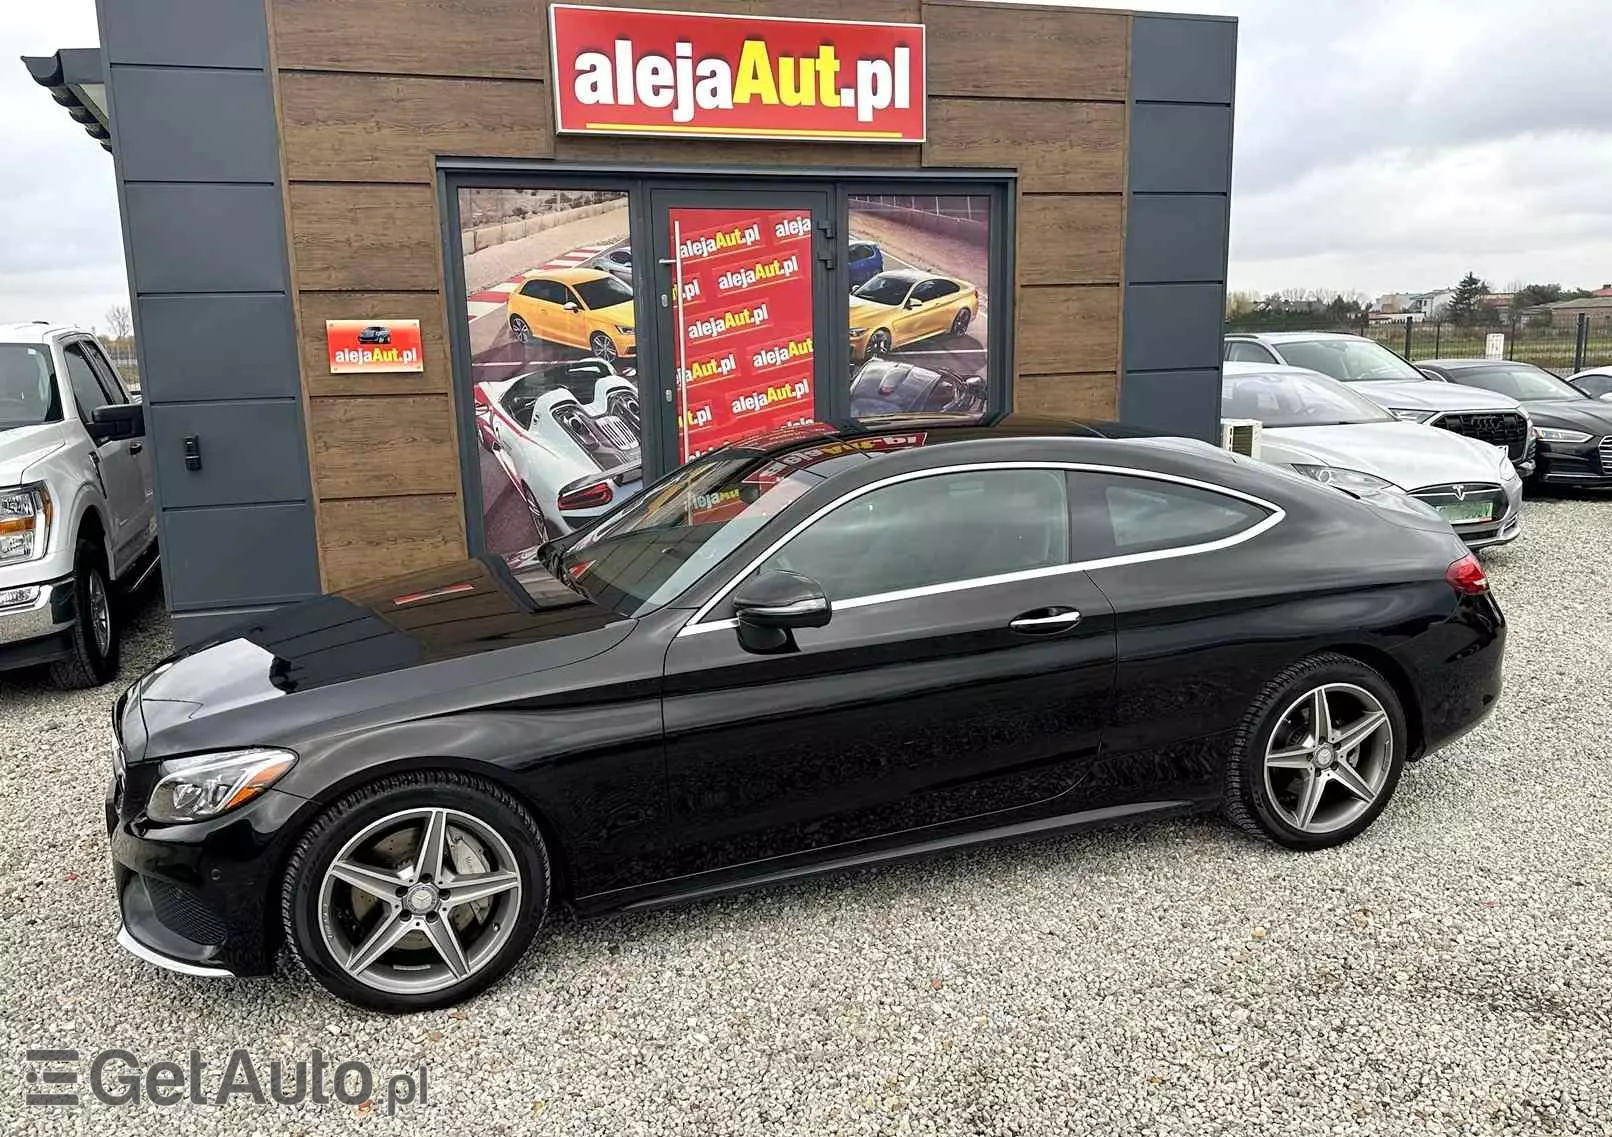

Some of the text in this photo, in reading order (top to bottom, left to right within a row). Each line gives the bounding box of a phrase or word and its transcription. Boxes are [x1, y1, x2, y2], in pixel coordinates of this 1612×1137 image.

[574, 39, 910, 122] alejaAut.pl
[679, 224, 760, 258] alejaAut.pl
[718, 255, 798, 290] alejaAut.pl
[688, 304, 768, 338] alejaAut.pl
[335, 347, 417, 364] alejaAut.pl
[752, 336, 813, 368] alejaAut
[731, 379, 809, 414] alejaAut.pl
